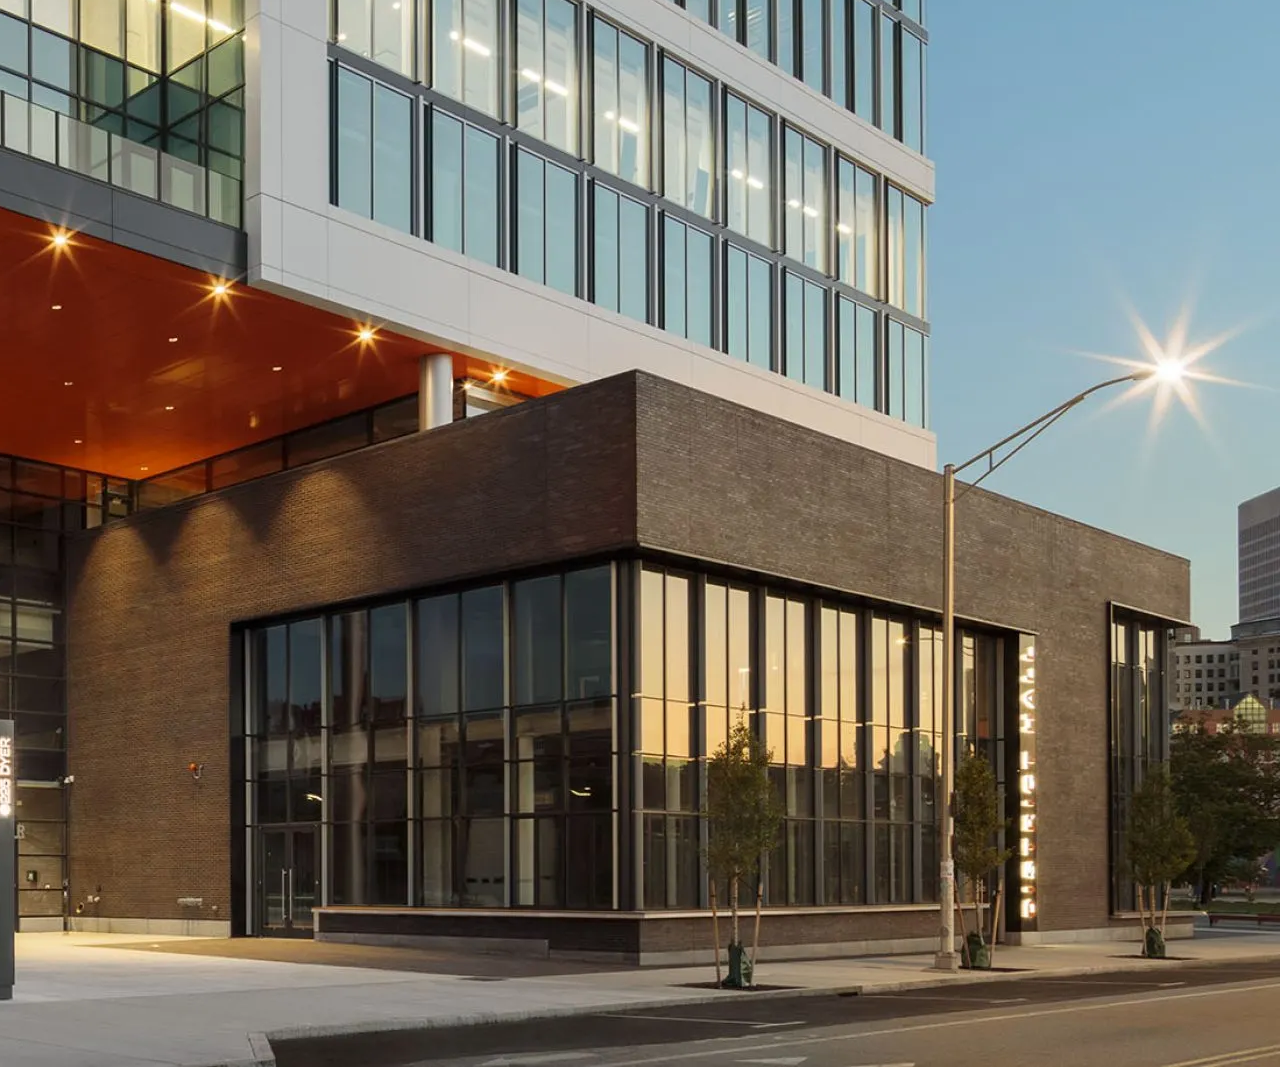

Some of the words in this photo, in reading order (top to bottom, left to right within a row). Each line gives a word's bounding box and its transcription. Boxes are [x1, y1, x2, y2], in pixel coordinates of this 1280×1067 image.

[1019, 646, 1036, 733] HALL
[0, 737, 11, 776] DYER
[1020, 750, 1036, 918] DISTRICT
